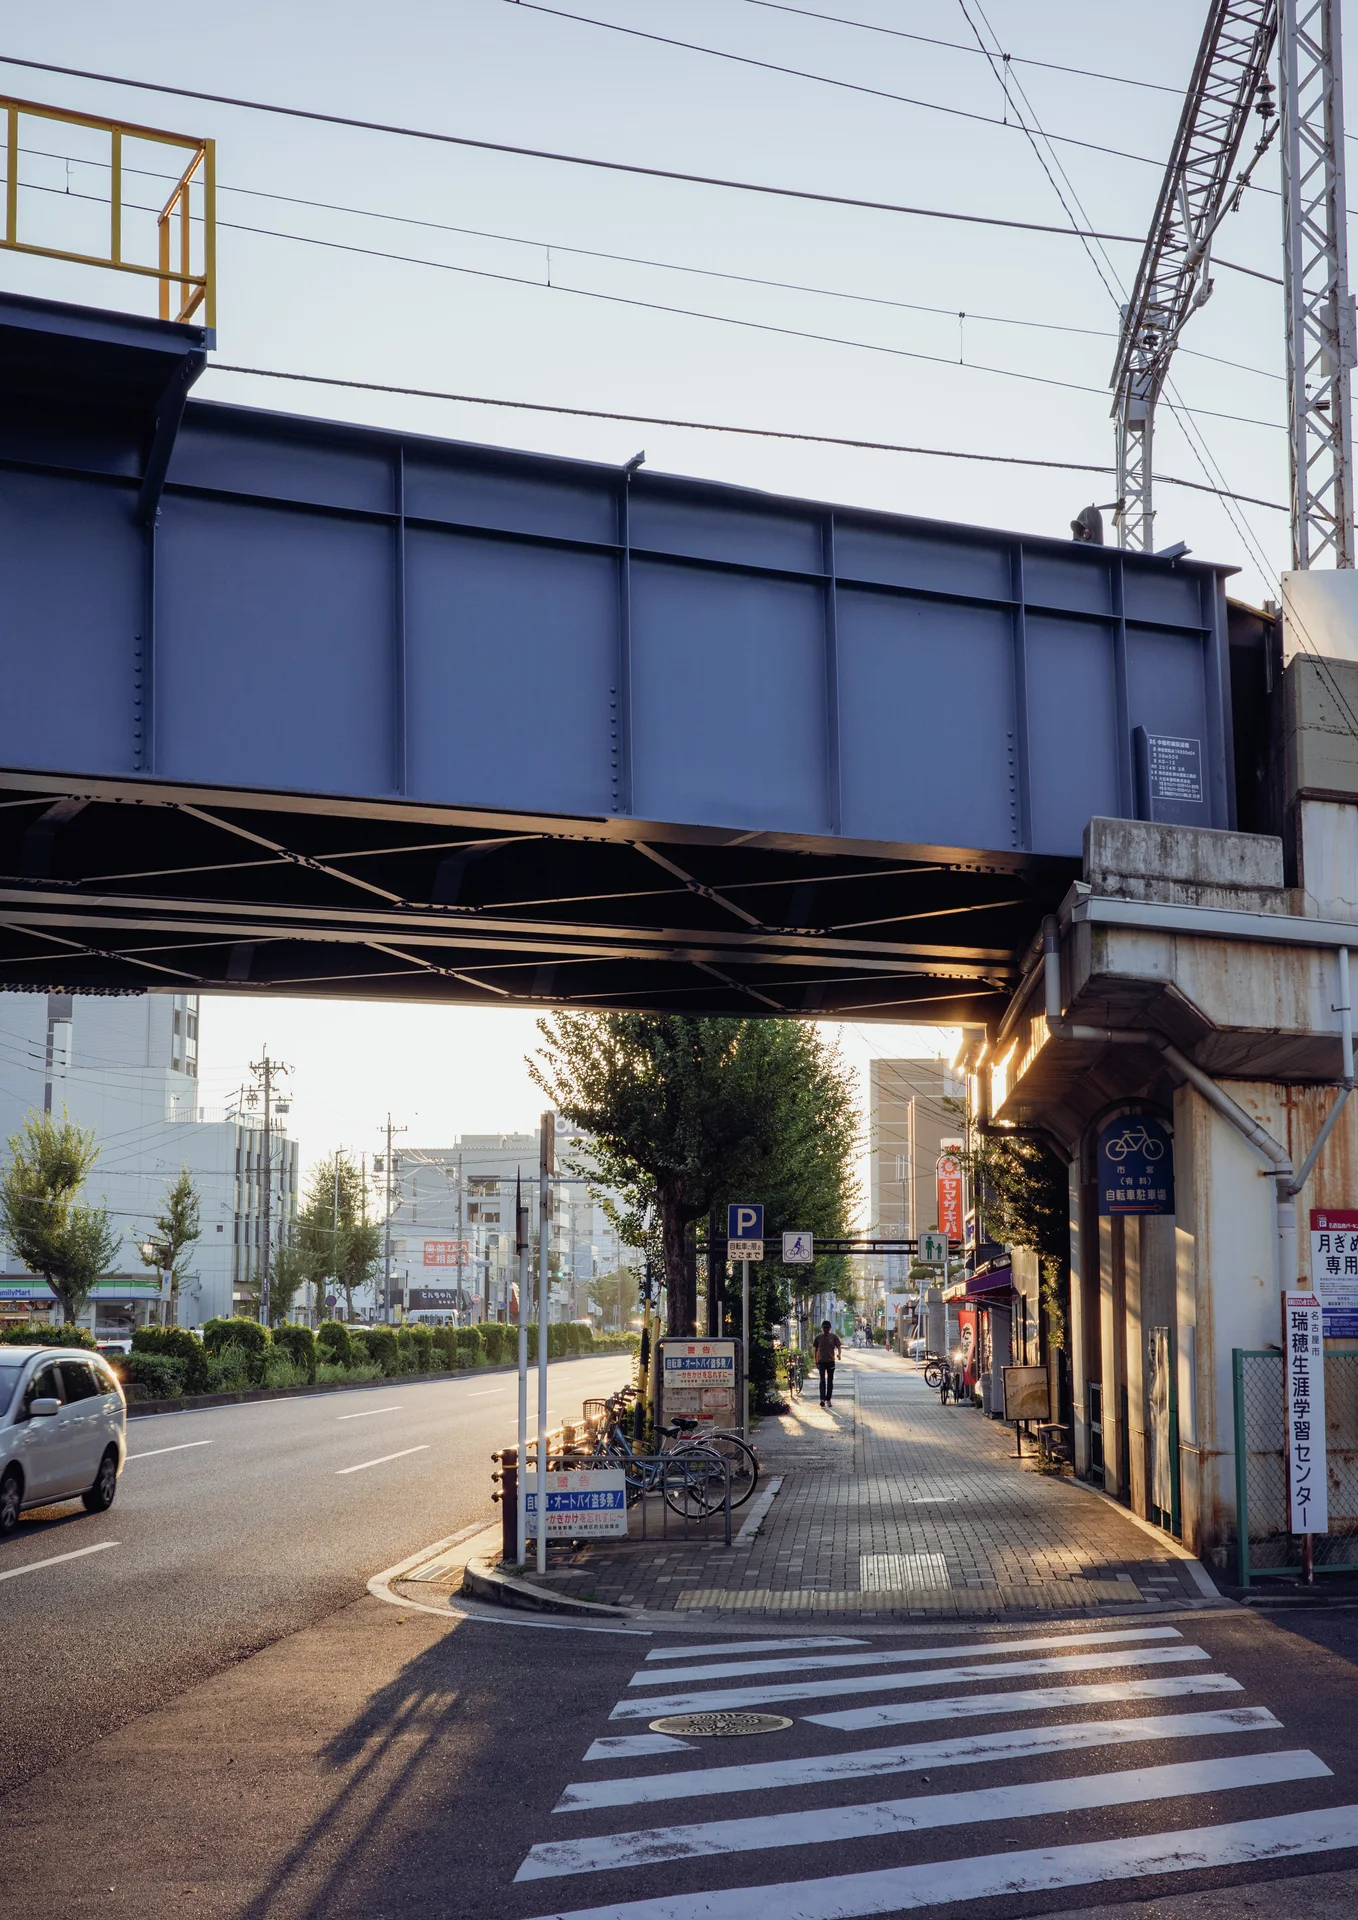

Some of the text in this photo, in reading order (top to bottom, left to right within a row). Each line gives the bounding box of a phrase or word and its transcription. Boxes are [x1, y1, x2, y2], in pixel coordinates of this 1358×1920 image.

[1106, 1189, 1167, 1201] 自転車駐車場
[737, 1208, 757, 1236] P
[730, 1242, 762, 1251] 自転車に限る
[421, 1291, 452, 1299] とんちゃん
[1311, 1311, 1320, 1356] 名古屋市
[687, 1346, 711, 1354] 警告
[1291, 1311, 1311, 1527] 瑞穂生涯学習センター
[557, 1475, 590, 1488] 警告
